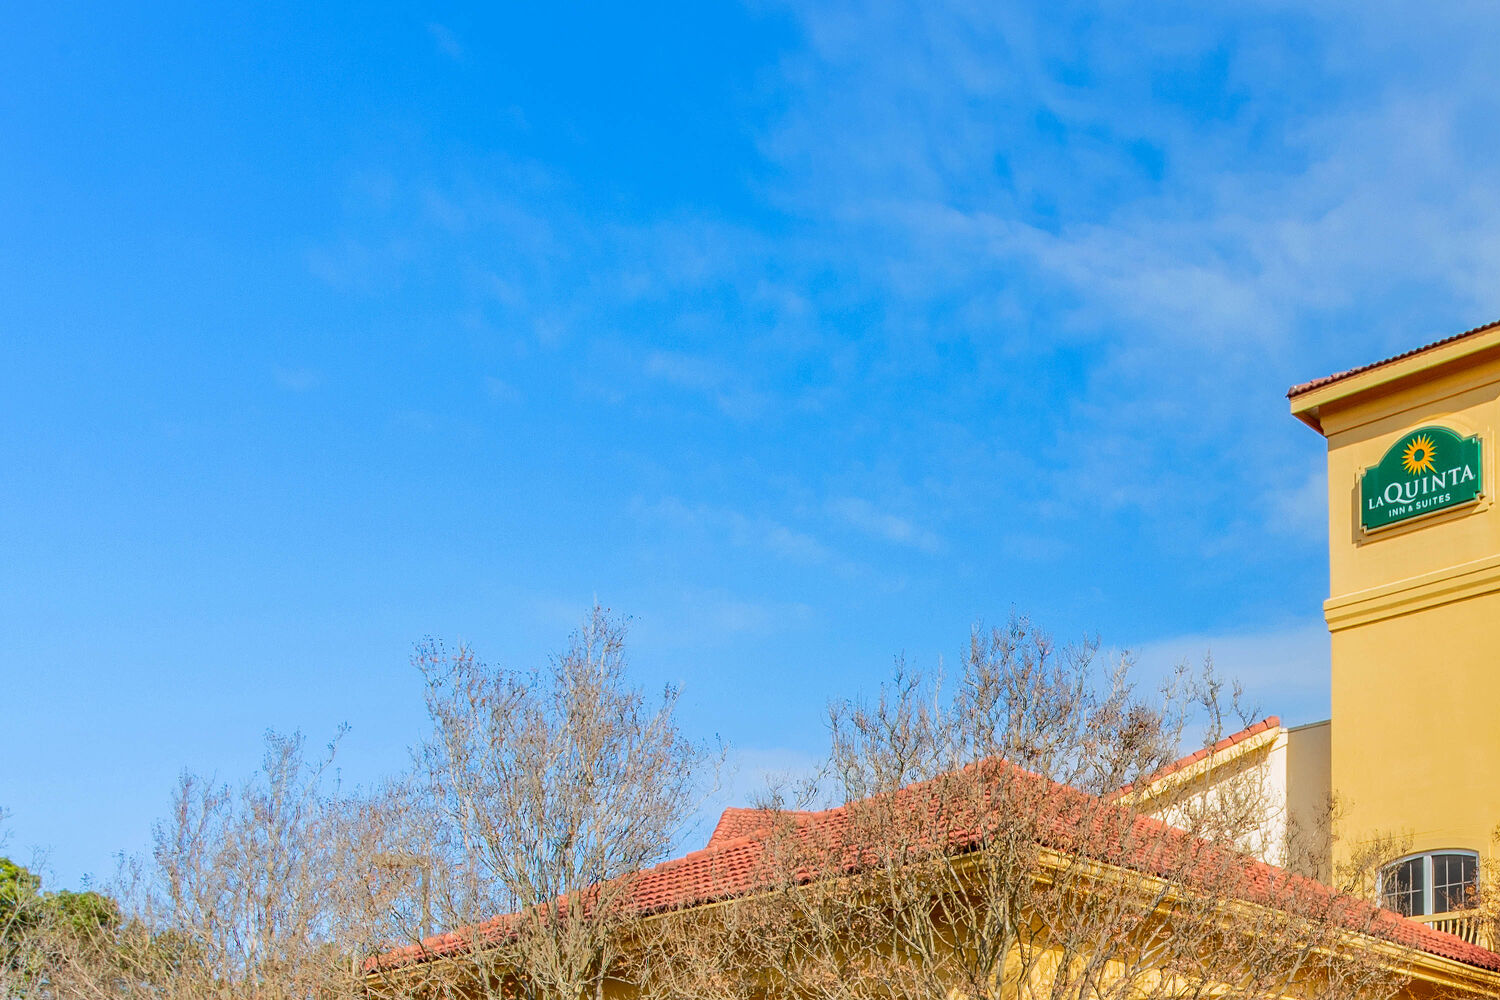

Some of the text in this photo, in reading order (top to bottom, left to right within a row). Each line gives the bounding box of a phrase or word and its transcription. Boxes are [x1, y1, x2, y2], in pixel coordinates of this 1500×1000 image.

[1384, 464, 1473, 504] QUINTA
[1388, 507, 1405, 517] INN
[1416, 493, 1451, 509] SUITES
